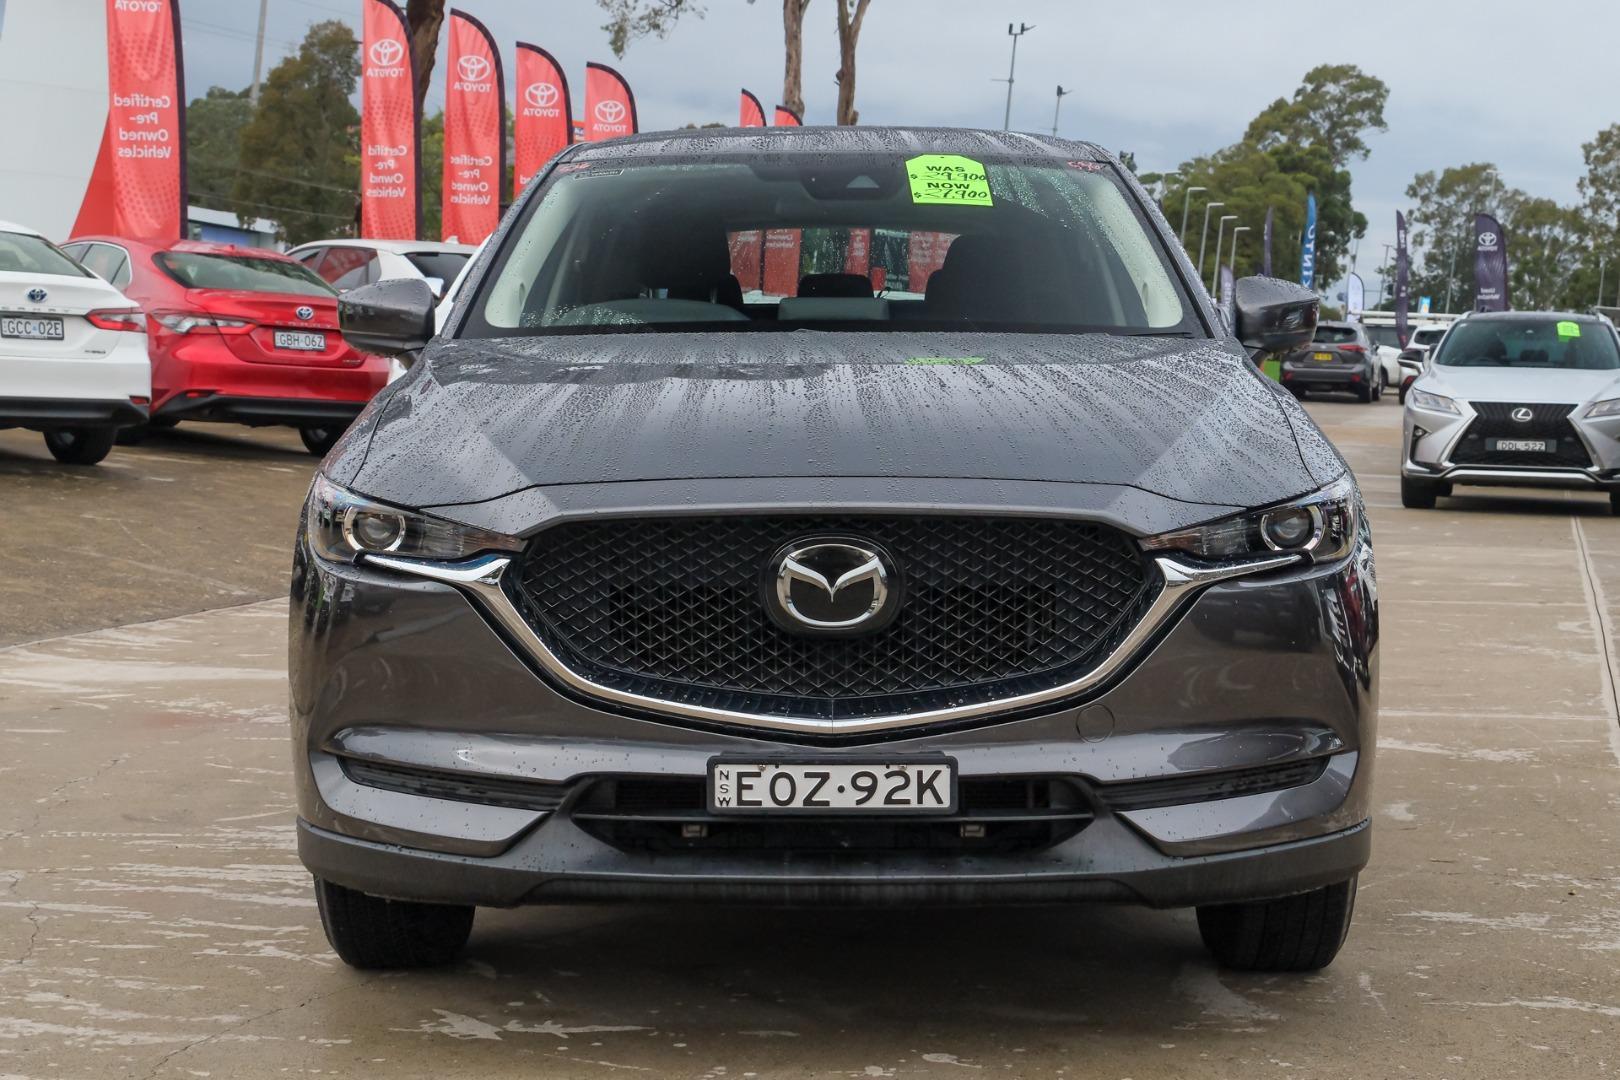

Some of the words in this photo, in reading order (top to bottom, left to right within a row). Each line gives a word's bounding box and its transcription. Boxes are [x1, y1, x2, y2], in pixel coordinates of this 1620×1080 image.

[7, 320, 32, 335] GCC
[38, 321, 61, 336] 02E
[279, 334, 300, 346] GBH
